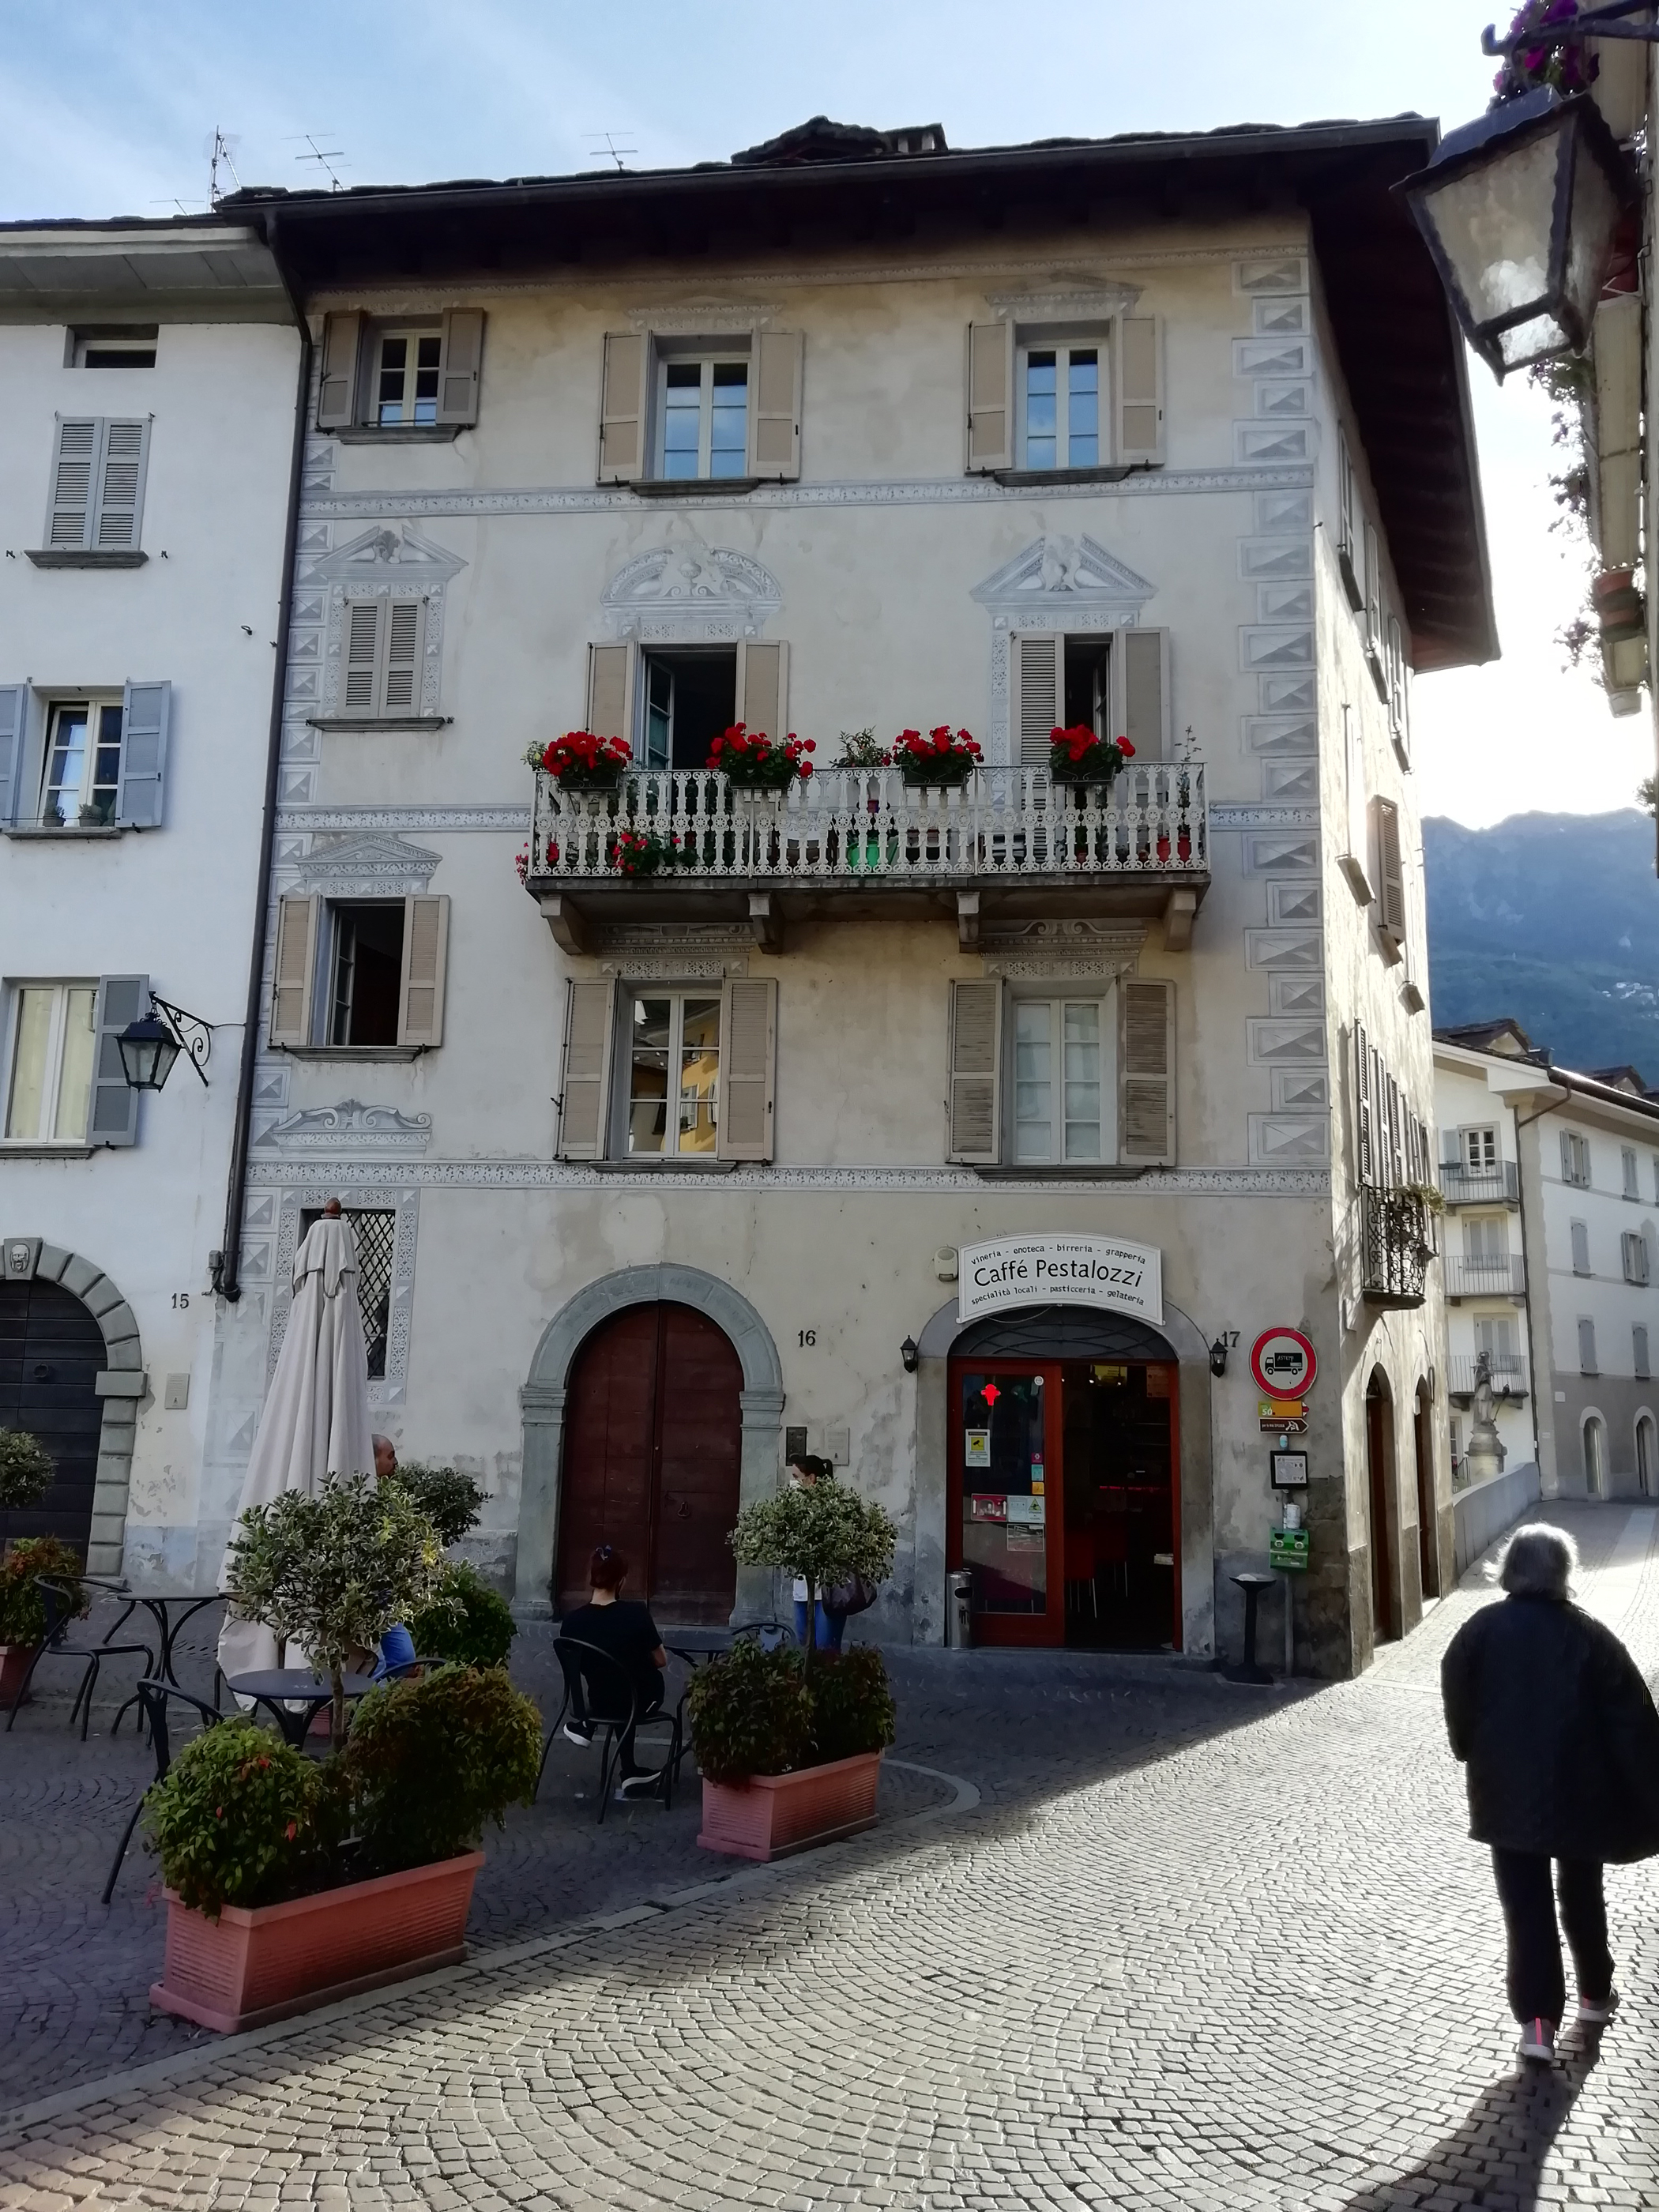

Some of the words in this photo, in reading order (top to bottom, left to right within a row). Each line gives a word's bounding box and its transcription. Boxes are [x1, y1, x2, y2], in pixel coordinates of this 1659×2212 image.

[971, 1251, 1002, 1265] vineria
[1014, 1245, 1044, 1255] enoteca
[1057, 1244, 1093, 1253] birreria
[1105, 1249, 1146, 1265] grapperia
[974, 1259, 1028, 1287] Caffé
[1036, 1259, 1143, 1288] Pestalozzi
[171, 1292, 190, 1309] 15
[971, 1288, 1011, 1305] specialità
[1014, 1285, 1037, 1294] locali
[1050, 1285, 1096, 1294] pasticceria
[1107, 1290, 1145, 1306] gelateria
[797, 1330, 816, 1348] 16
[1221, 1330, 1241, 1348] 17
